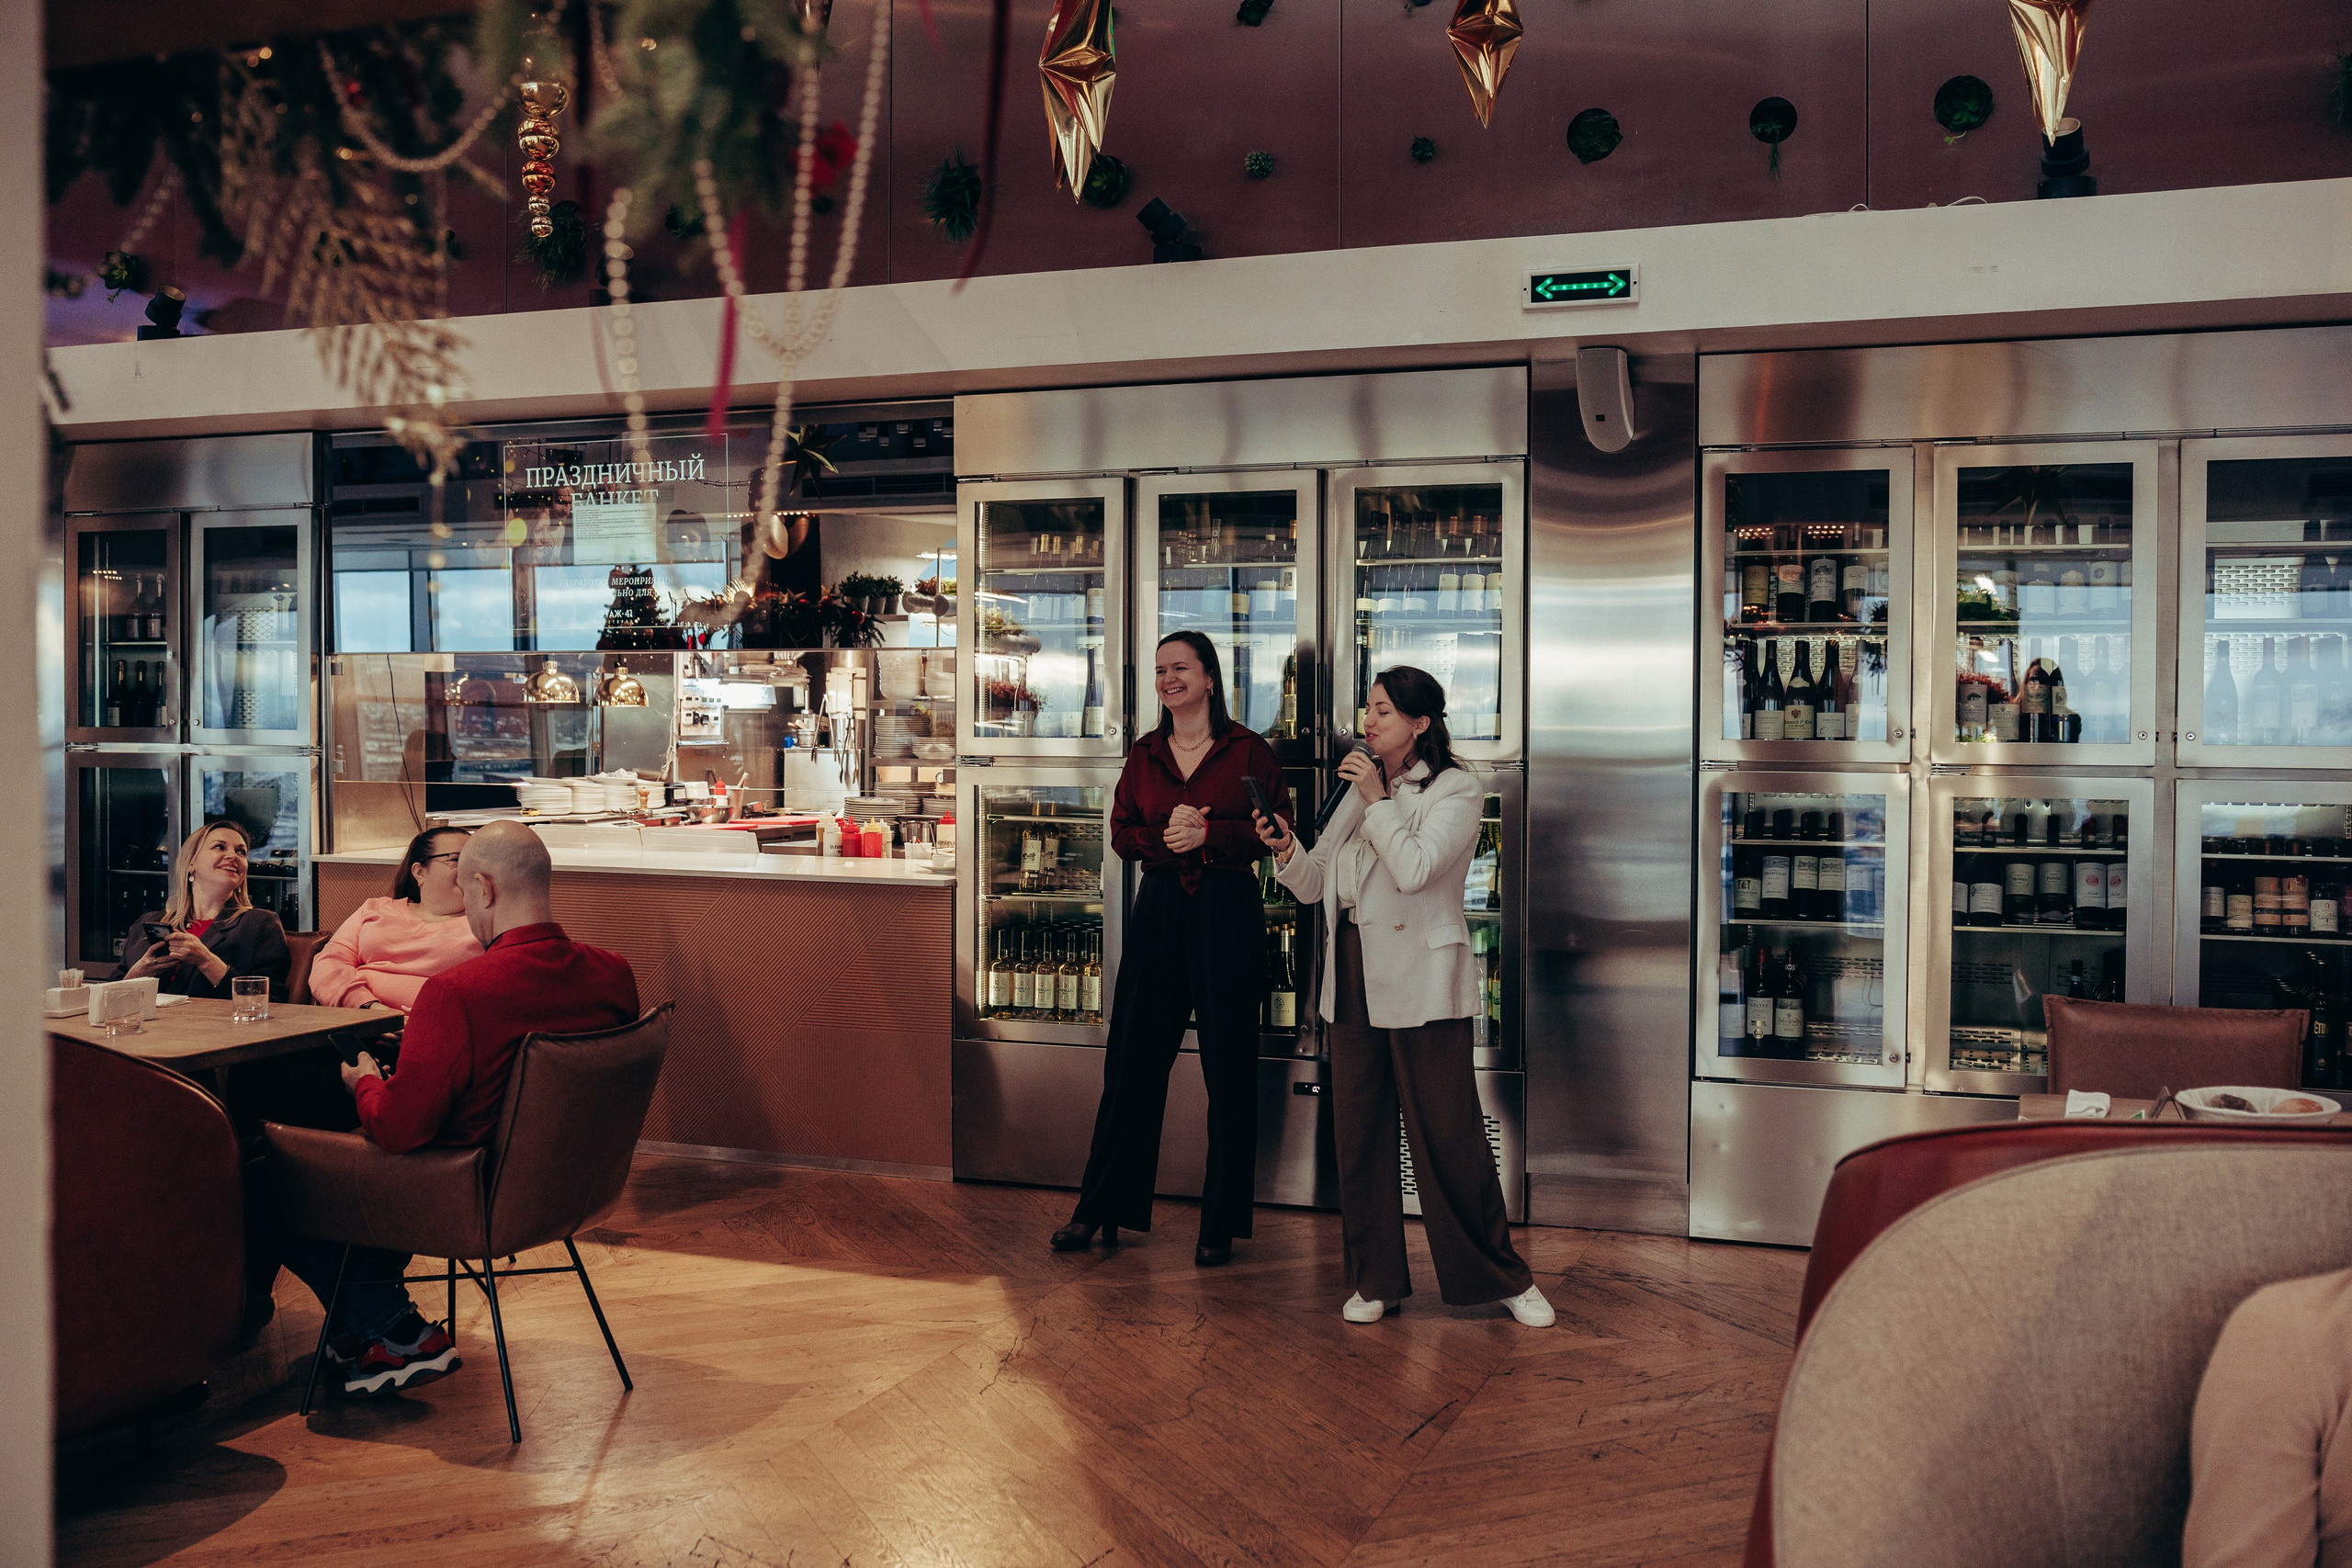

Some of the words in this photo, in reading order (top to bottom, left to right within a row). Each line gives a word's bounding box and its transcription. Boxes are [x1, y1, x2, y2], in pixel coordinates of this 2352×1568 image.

[525, 453, 705, 490] ПРАЗДНИЧНЫЙ
[611, 576, 673, 586] МЕРОПРИЯТИЯ
[635, 588, 653, 598] ДЛЯ
